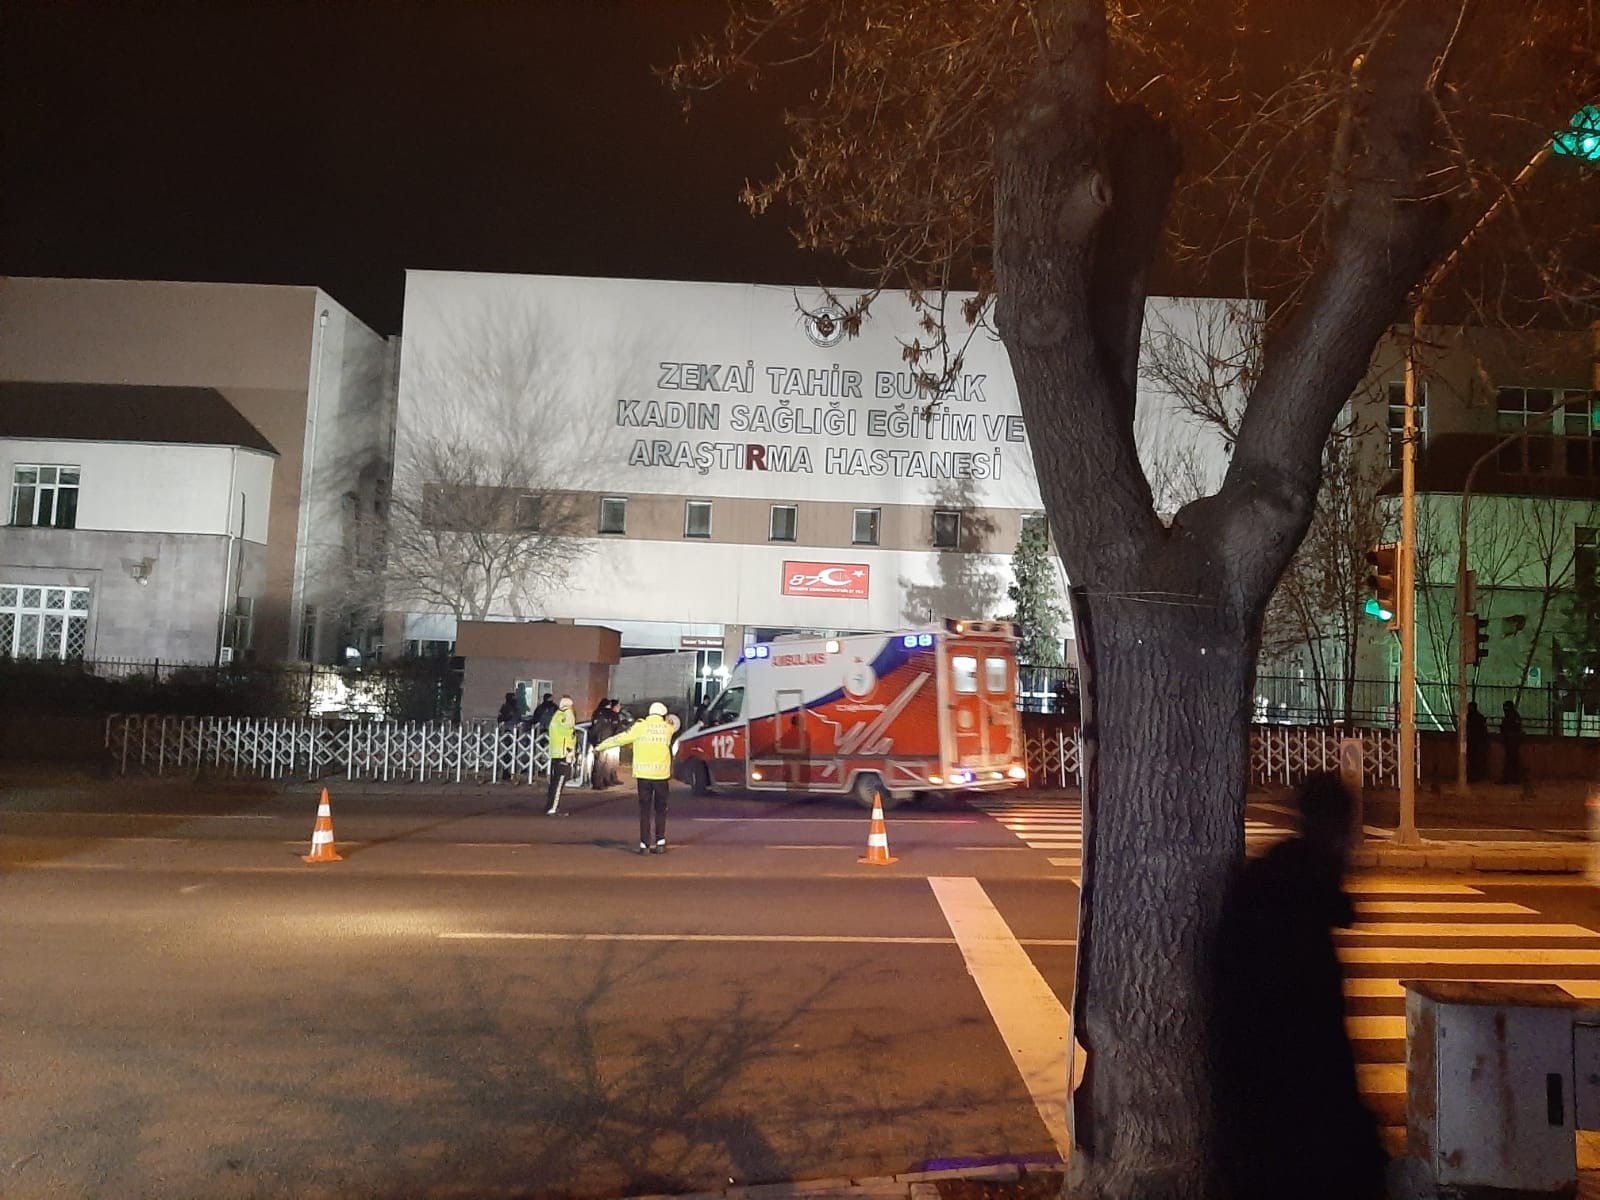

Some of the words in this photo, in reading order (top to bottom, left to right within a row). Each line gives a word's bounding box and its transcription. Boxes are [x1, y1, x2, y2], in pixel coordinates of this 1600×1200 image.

[657, 360, 754, 393] ZEKAİ
[766, 363, 863, 398] TAHİR
[616, 400, 720, 430] KADIN
[730, 400, 856, 436] SAĞLIĞI
[867, 403, 976, 441] EĞİTİM
[982, 414, 1025, 442] VE
[628, 439, 813, 475] ARAŞTIRMA
[825, 446, 1001, 480] HASTANESİ
[711, 735, 736, 759] 112
